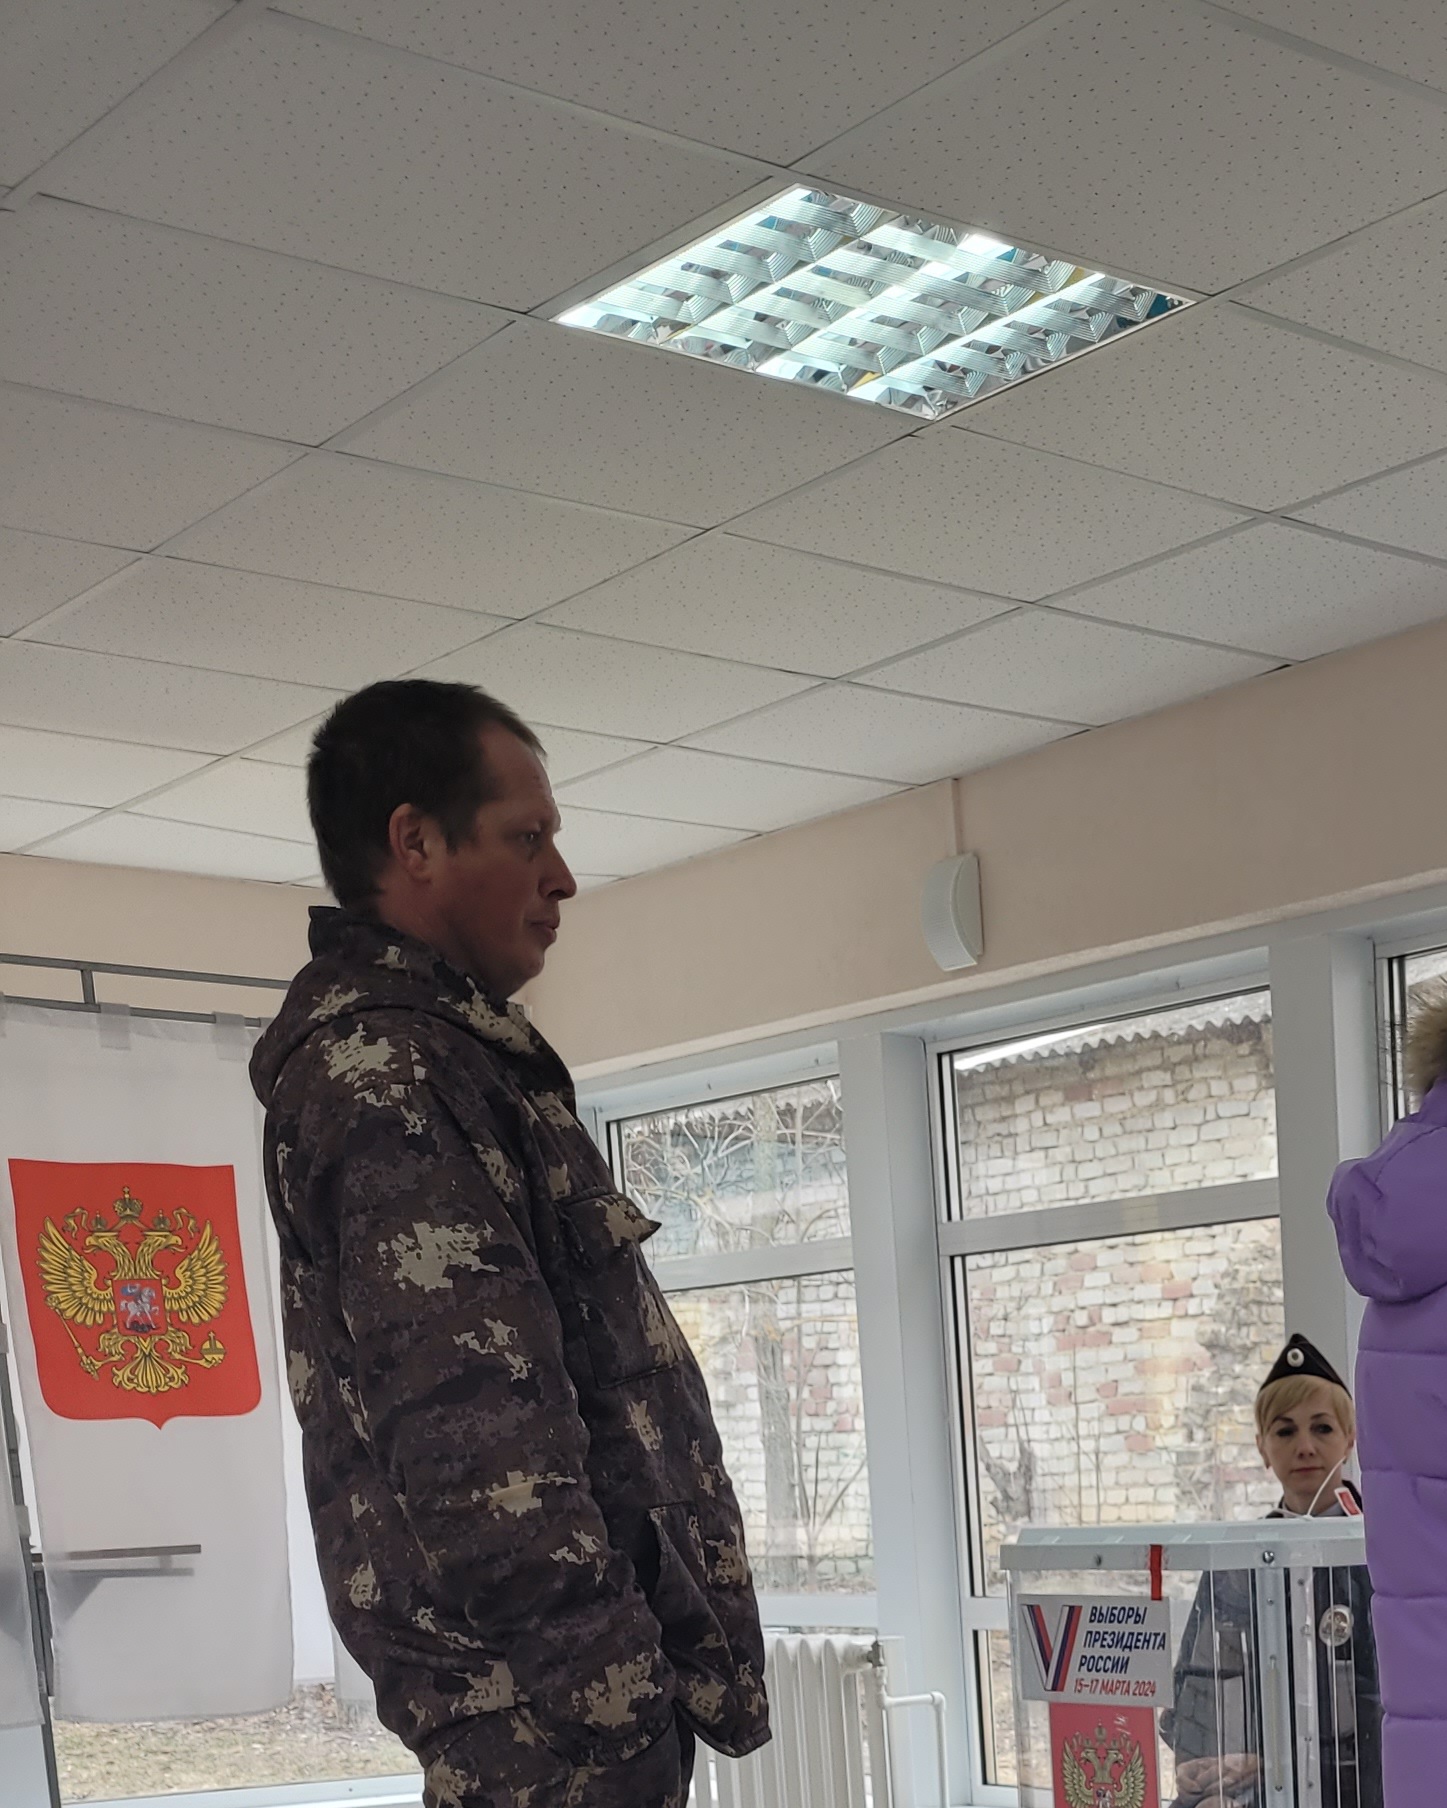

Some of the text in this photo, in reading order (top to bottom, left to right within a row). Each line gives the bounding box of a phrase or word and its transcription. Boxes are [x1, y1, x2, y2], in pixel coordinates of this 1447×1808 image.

[1088, 1605, 1148, 1625] ВЫБОРЫ
[1083, 1630, 1166, 1653] ПРЕЗИДЕНТА
[1077, 1654, 1130, 1675] РОССИИ
[1099, 1679, 1131, 1696] МАРТА
[1132, 1680, 1156, 1698] 2024
